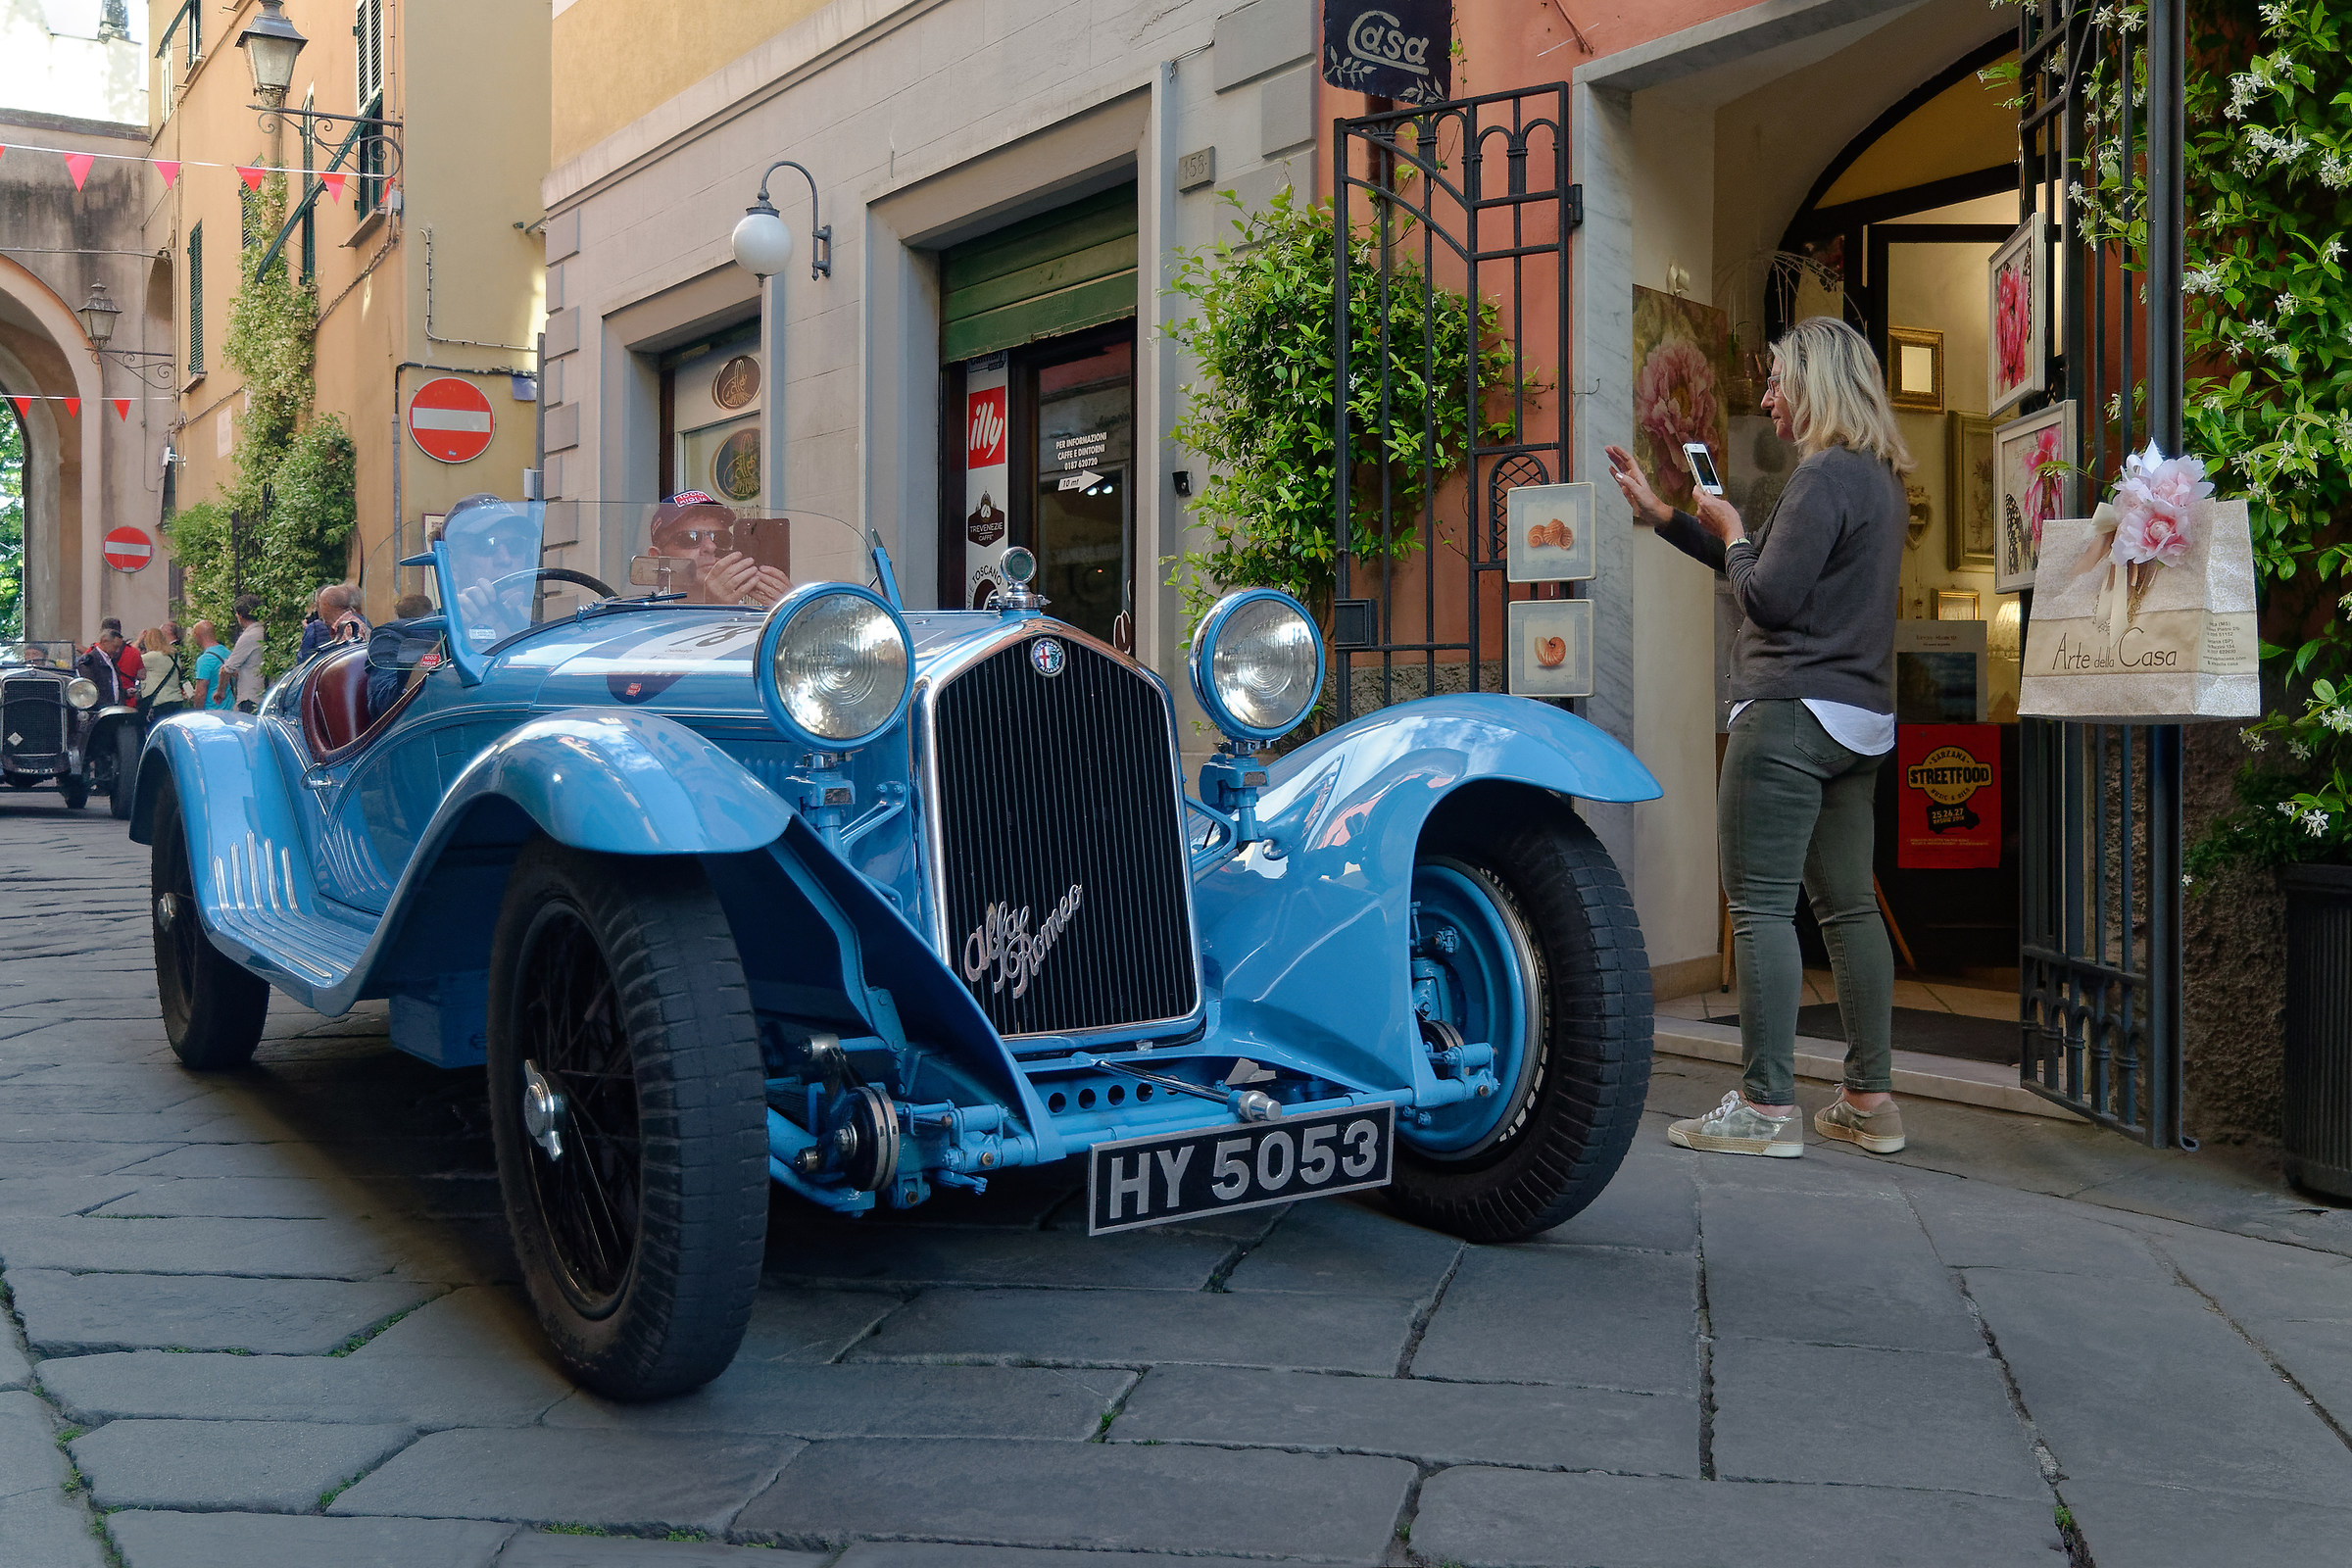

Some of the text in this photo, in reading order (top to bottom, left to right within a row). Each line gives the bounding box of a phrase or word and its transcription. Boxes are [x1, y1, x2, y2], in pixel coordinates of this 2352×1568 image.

[1347, 10, 1430, 76] Casa
[970, 402, 1004, 460] illy
[1055, 432, 1107, 450] PER INFORMAZIONI
[1074, 449, 1078, 458] E
[1078, 444, 1105, 457] DINTORNI
[1064, 457, 1099, 470] 0187 620720
[1062, 479, 1070, 488] 10
[969, 521, 1004, 533] TREVENEZIE
[972, 564, 1003, 586] TOSCANO
[2052, 626, 2178, 670] Arte della Casa
[1932, 750, 1967, 762] SARZANA
[1910, 766, 1989, 784] STREETFOOD
[1005, 884, 1082, 1000] Romeo
[1109, 1119, 1380, 1219] HY 5053
